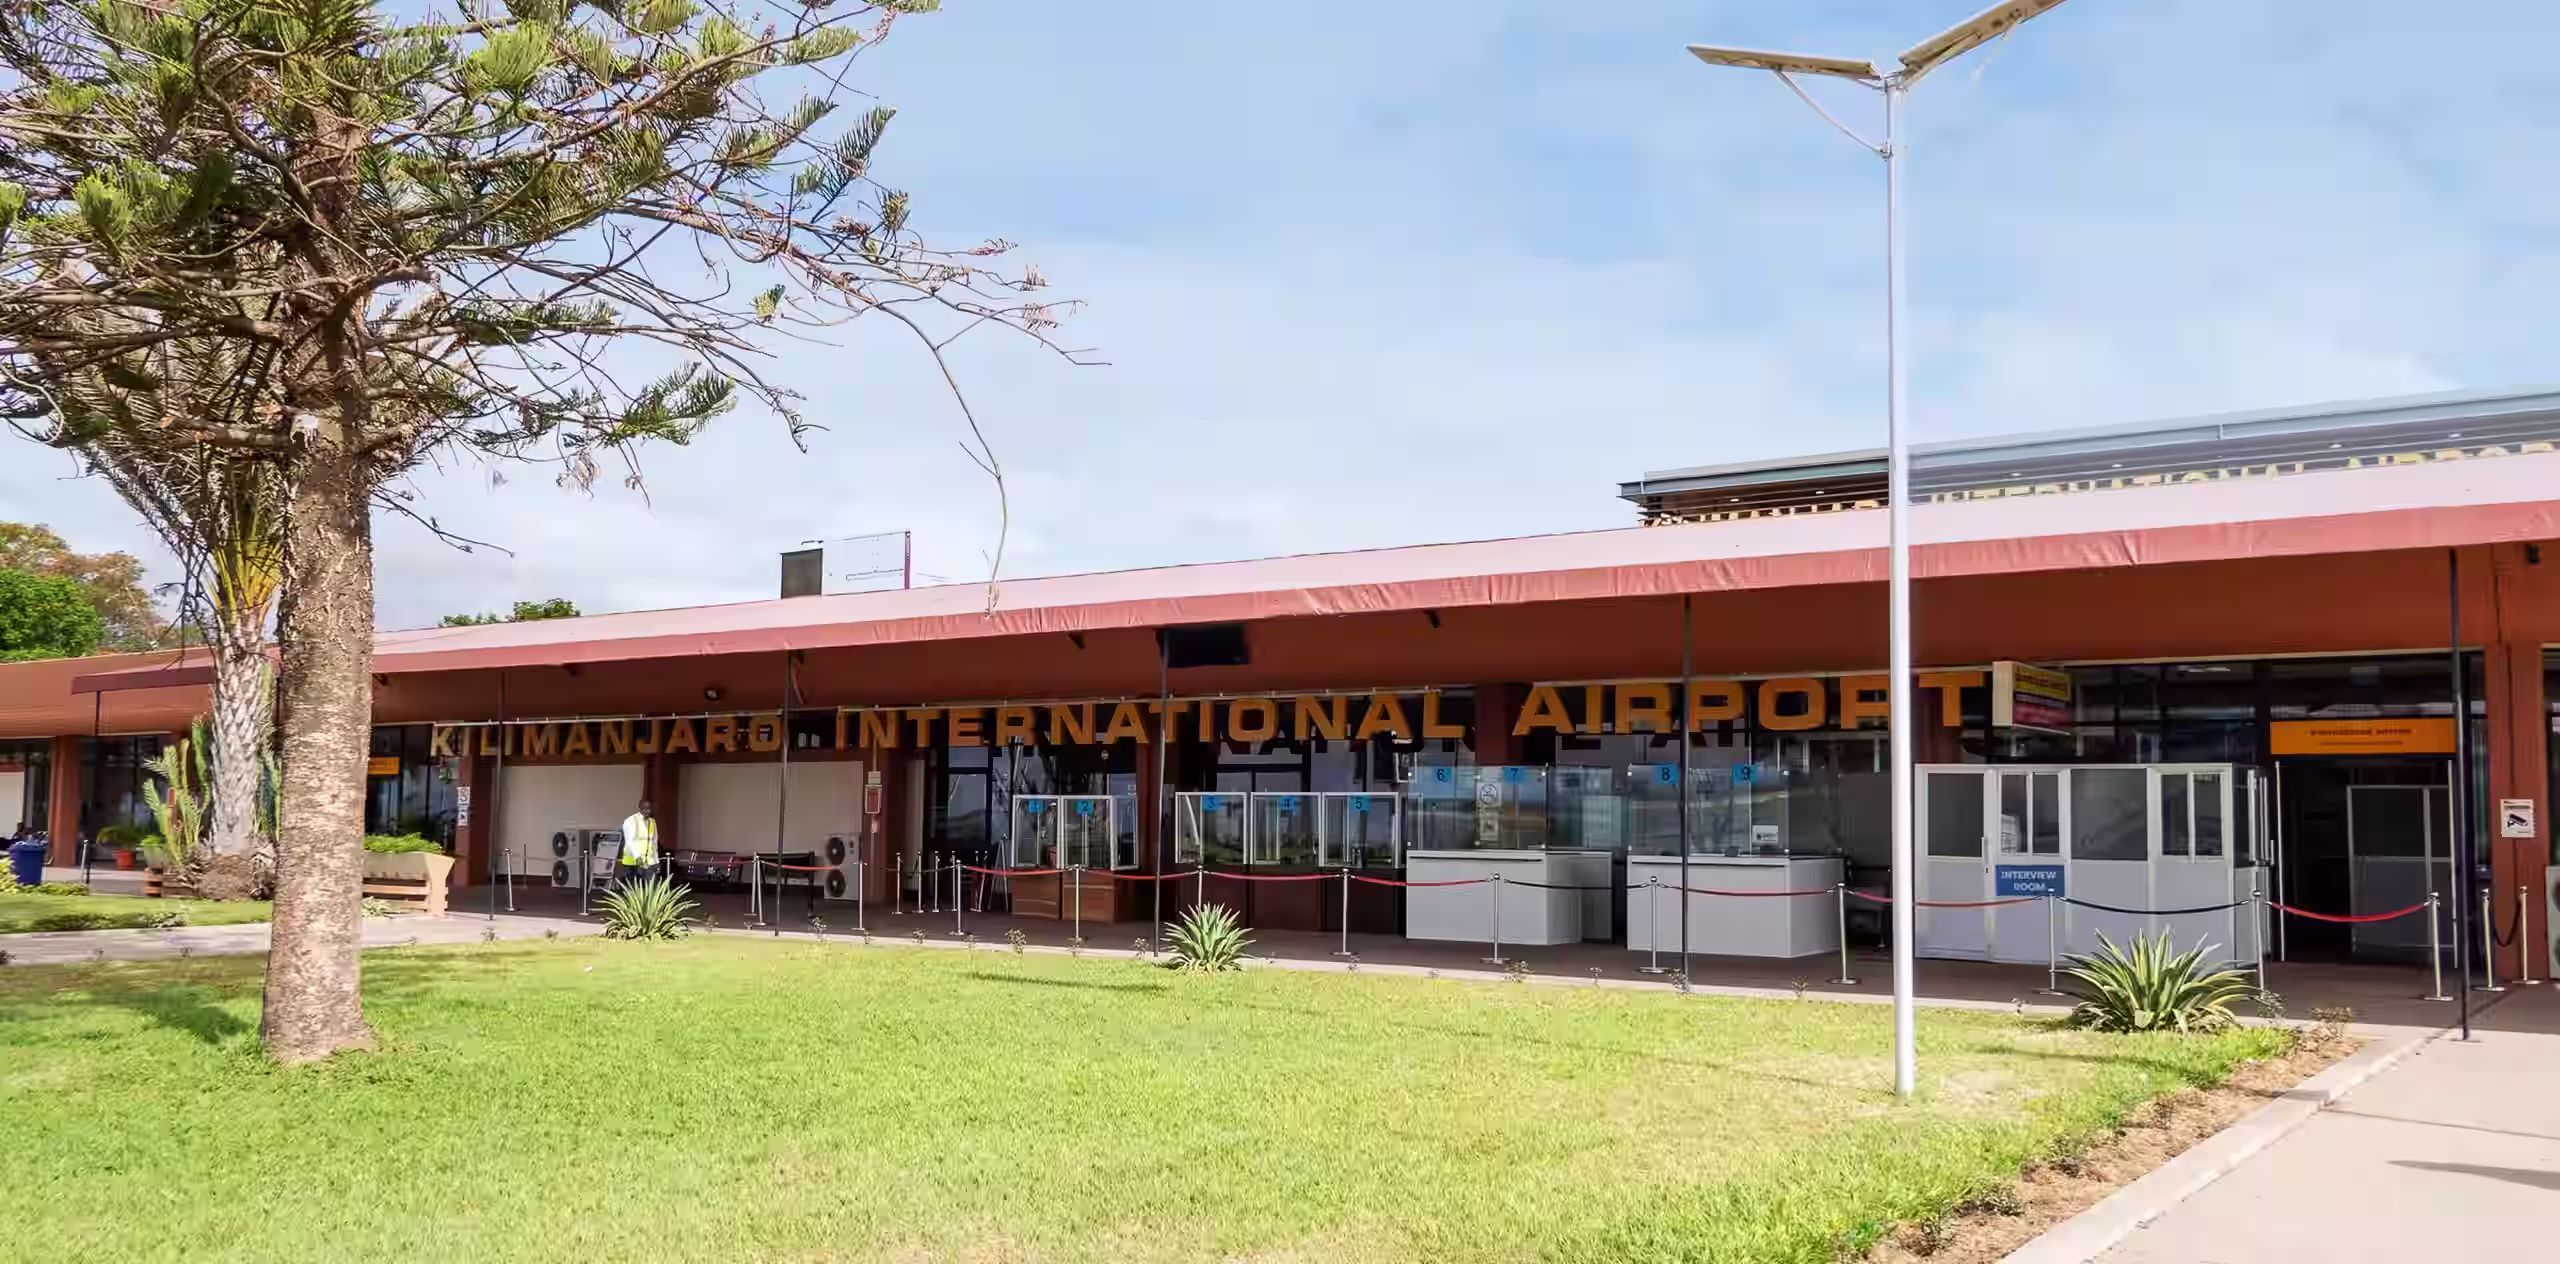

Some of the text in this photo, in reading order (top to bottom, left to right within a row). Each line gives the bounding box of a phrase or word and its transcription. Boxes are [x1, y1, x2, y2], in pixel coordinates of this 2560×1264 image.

[430, 716, 782, 757] KILIMANJARO
[835, 694, 1465, 748] INTERNATIONAL
[1512, 672, 1984, 735] AIRPORT
[1661, 767, 1671, 781] 8
[2001, 871, 2057, 880] INTERVIEW
[2013, 882, 2047, 892] ROOM
